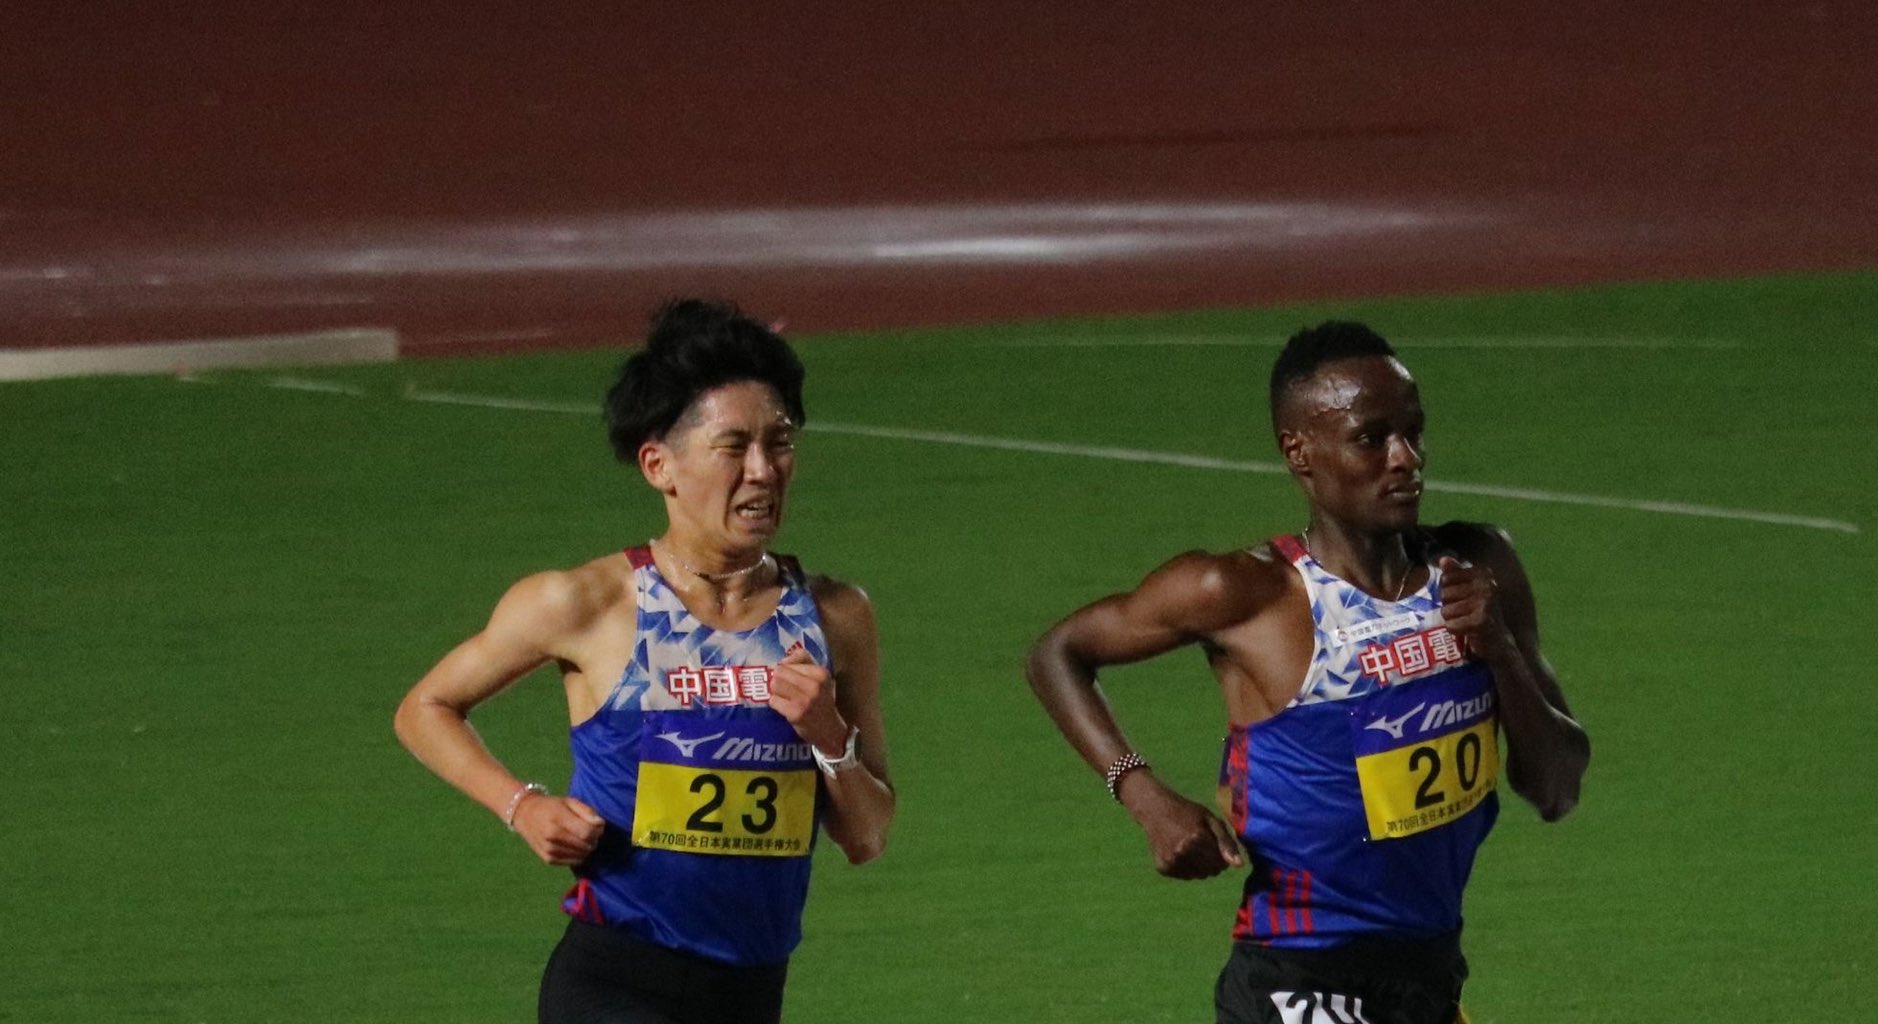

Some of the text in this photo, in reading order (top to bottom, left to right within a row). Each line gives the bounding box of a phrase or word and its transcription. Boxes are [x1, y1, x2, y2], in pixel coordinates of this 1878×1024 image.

[667, 666, 773, 706] 中国電
[1358, 625, 1462, 687] 中国電
[1418, 692, 1493, 732] MIZUN
[1408, 733, 1481, 811] 20
[685, 773, 779, 835] 23
